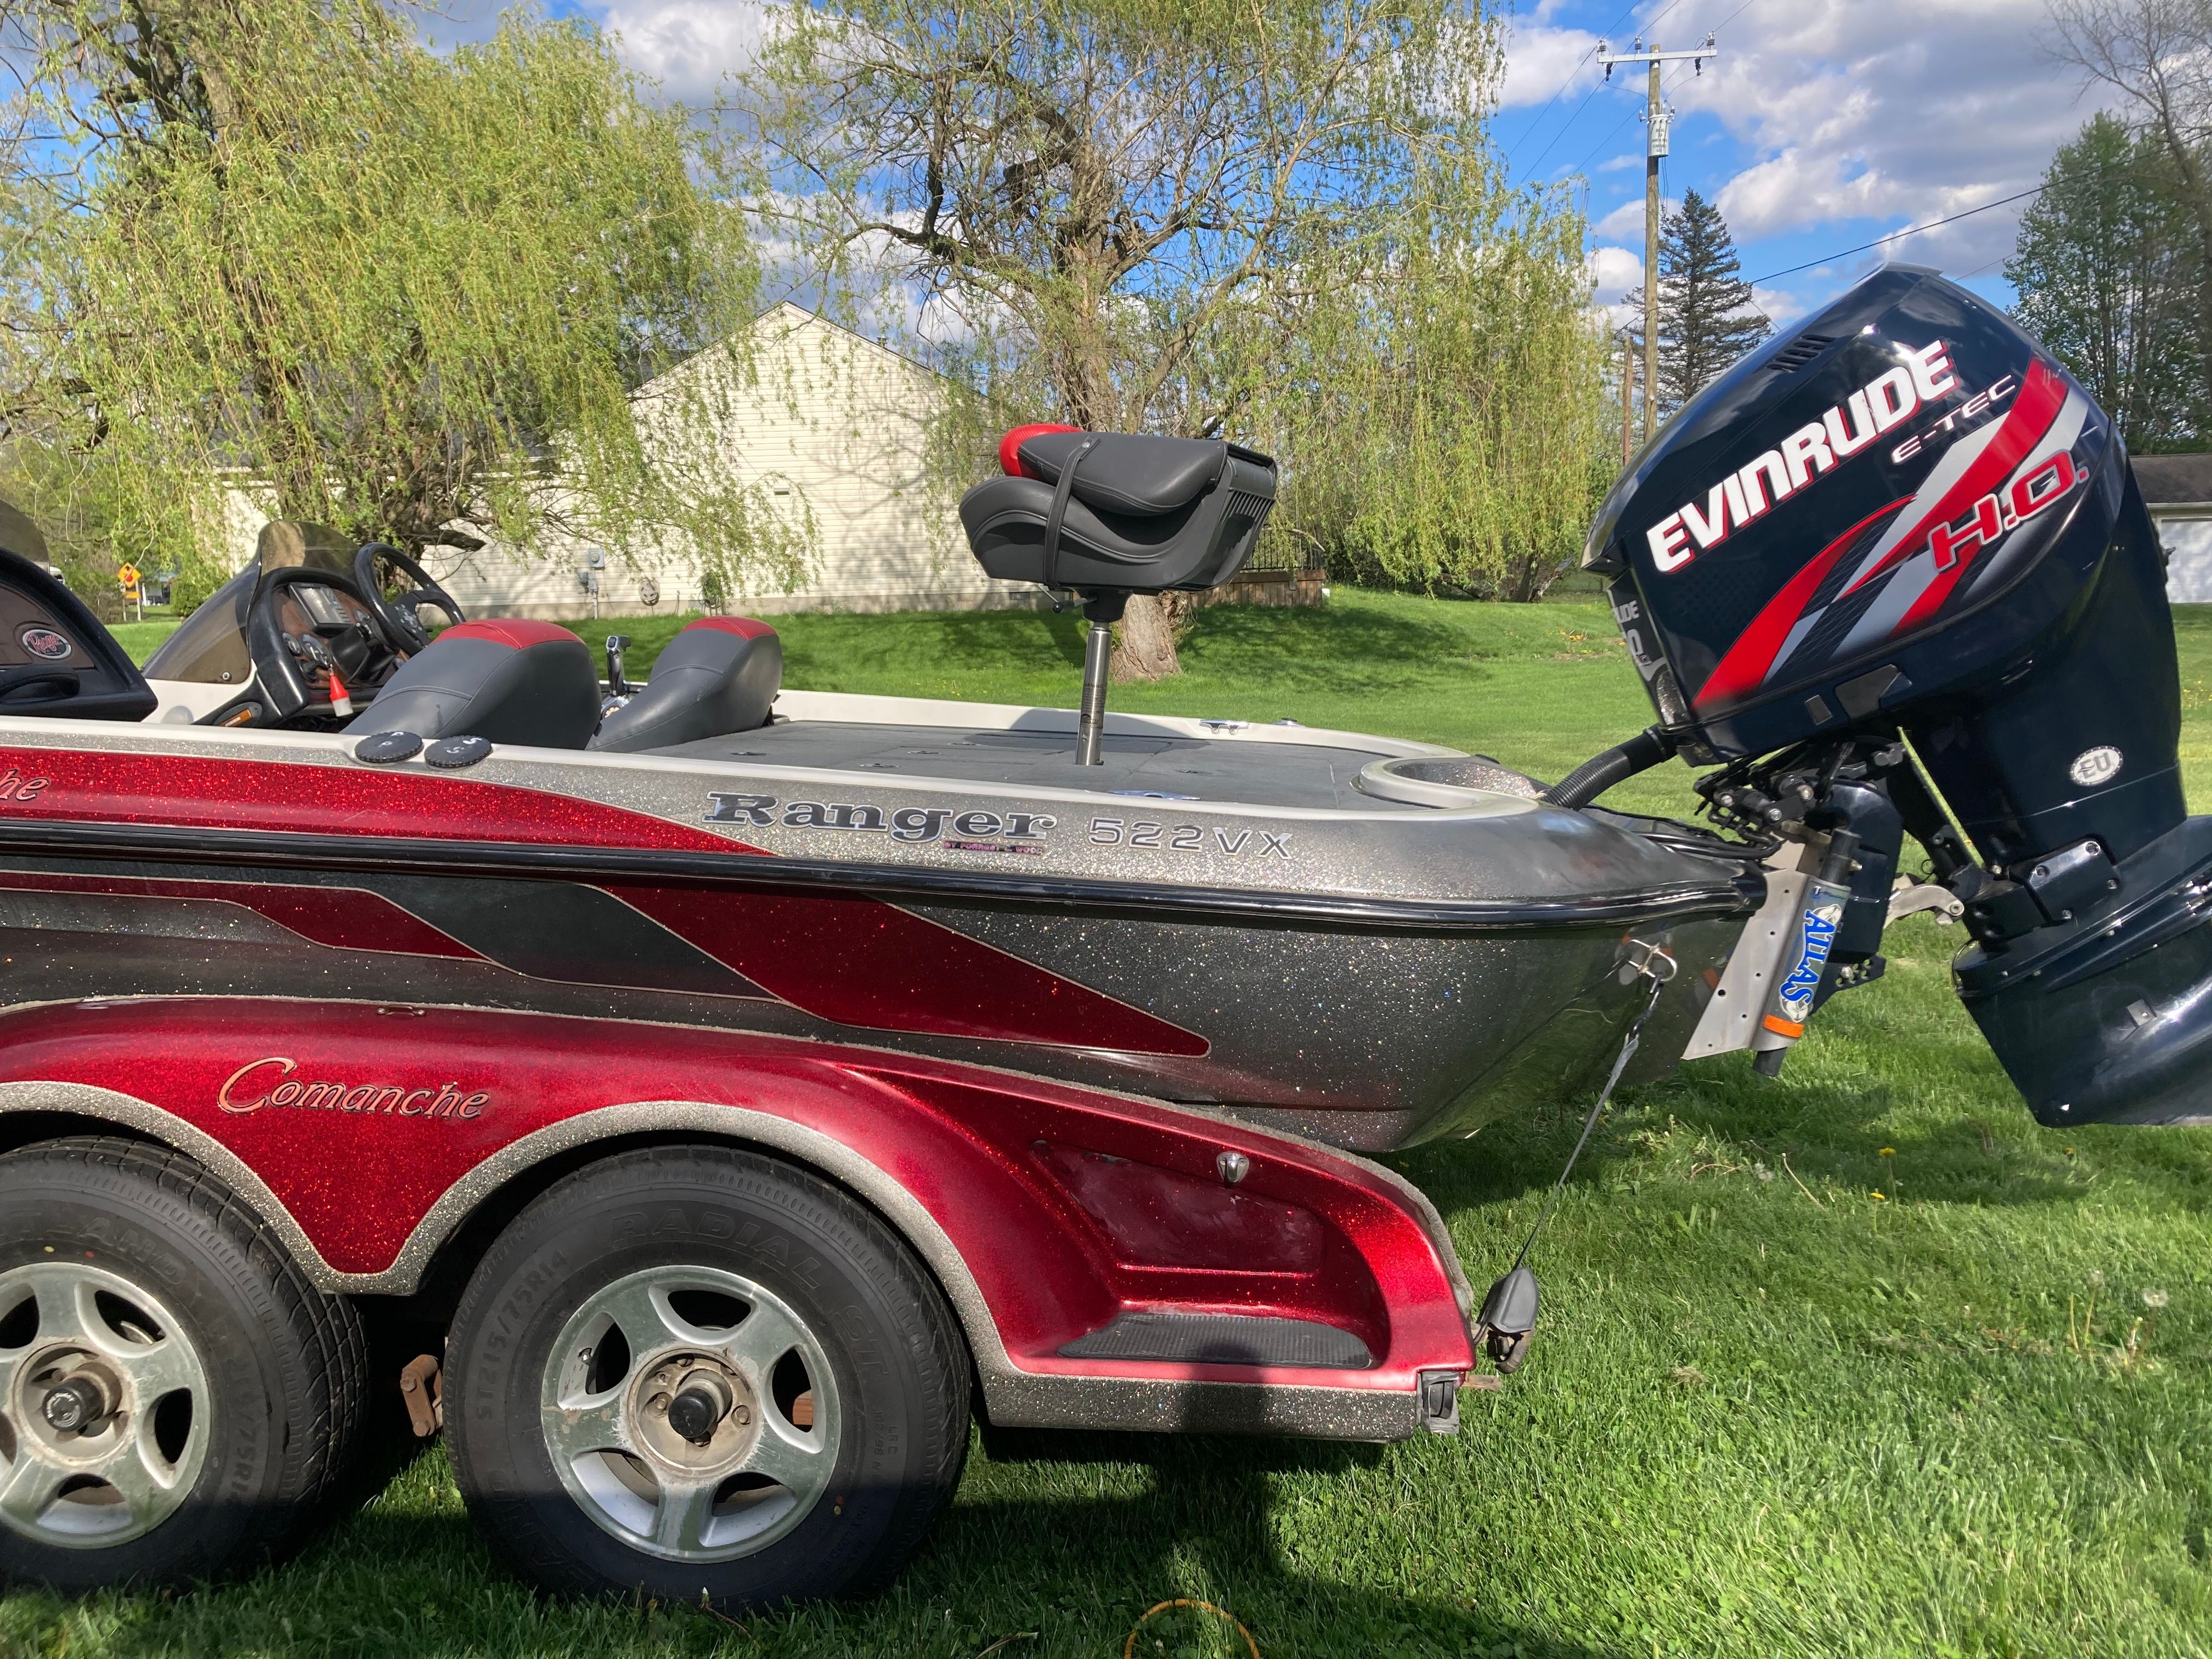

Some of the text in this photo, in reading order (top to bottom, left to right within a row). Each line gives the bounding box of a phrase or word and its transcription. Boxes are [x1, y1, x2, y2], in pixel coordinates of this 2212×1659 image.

[1647, 339, 1960, 573] EVINRUDE
[1892, 375, 2016, 465] E-TEC
[702, 791, 1057, 843] Ranger
[1780, 909, 1837, 1005] ATLAS
[218, 1057, 490, 1120] Comanche
